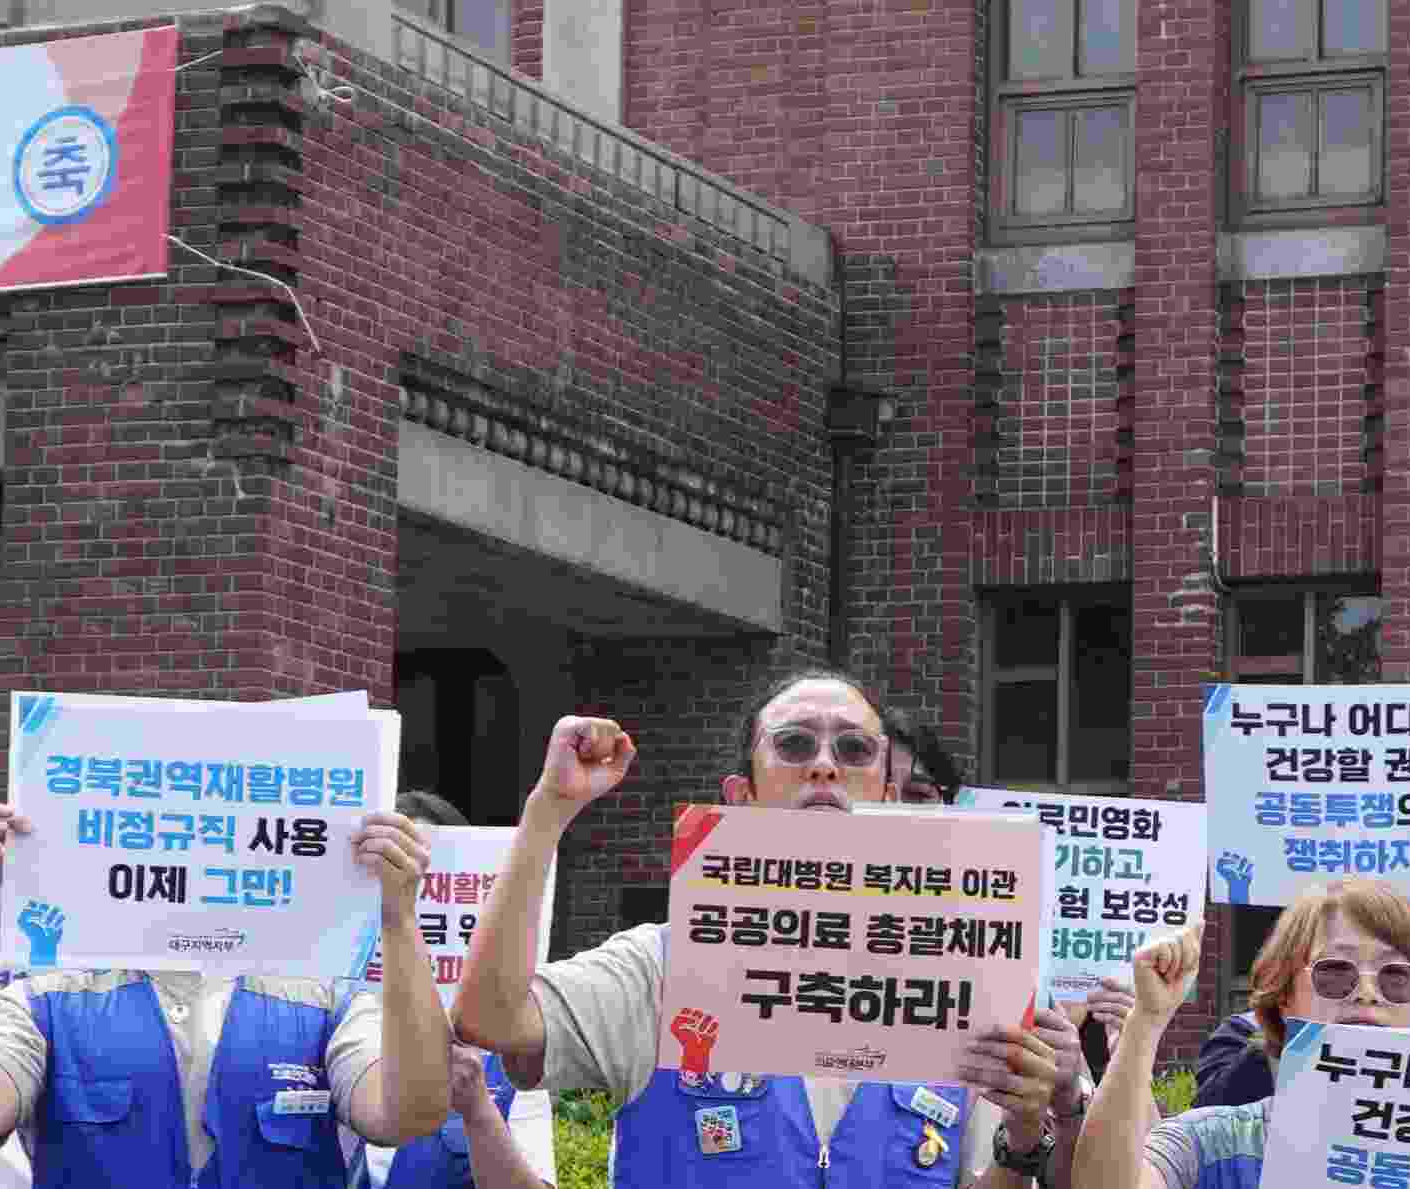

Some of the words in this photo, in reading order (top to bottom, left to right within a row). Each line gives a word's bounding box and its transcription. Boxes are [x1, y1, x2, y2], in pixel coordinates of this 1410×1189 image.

[36, 137, 91, 197] 축
[1231, 702, 1333, 737] 누구나
[45, 754, 364, 807] 경북권역재활병원
[1265, 747, 1372, 783] 건강할
[78, 808, 236, 852] 비정규직
[248, 817, 328, 857] 사용
[1003, 801, 1161, 841] 료민영화
[108, 863, 187, 904] 이제
[199, 865, 293, 906] 그만!
[701, 856, 853, 891] 국립대병원
[864, 861, 951, 896] 복지부
[962, 869, 1018, 899] 이관
[1101, 889, 1188, 925] 보장성
[689, 904, 851, 950] 공공의료
[866, 913, 1022, 961] 총괄체계
[741, 969, 973, 1031] 구축하라!
